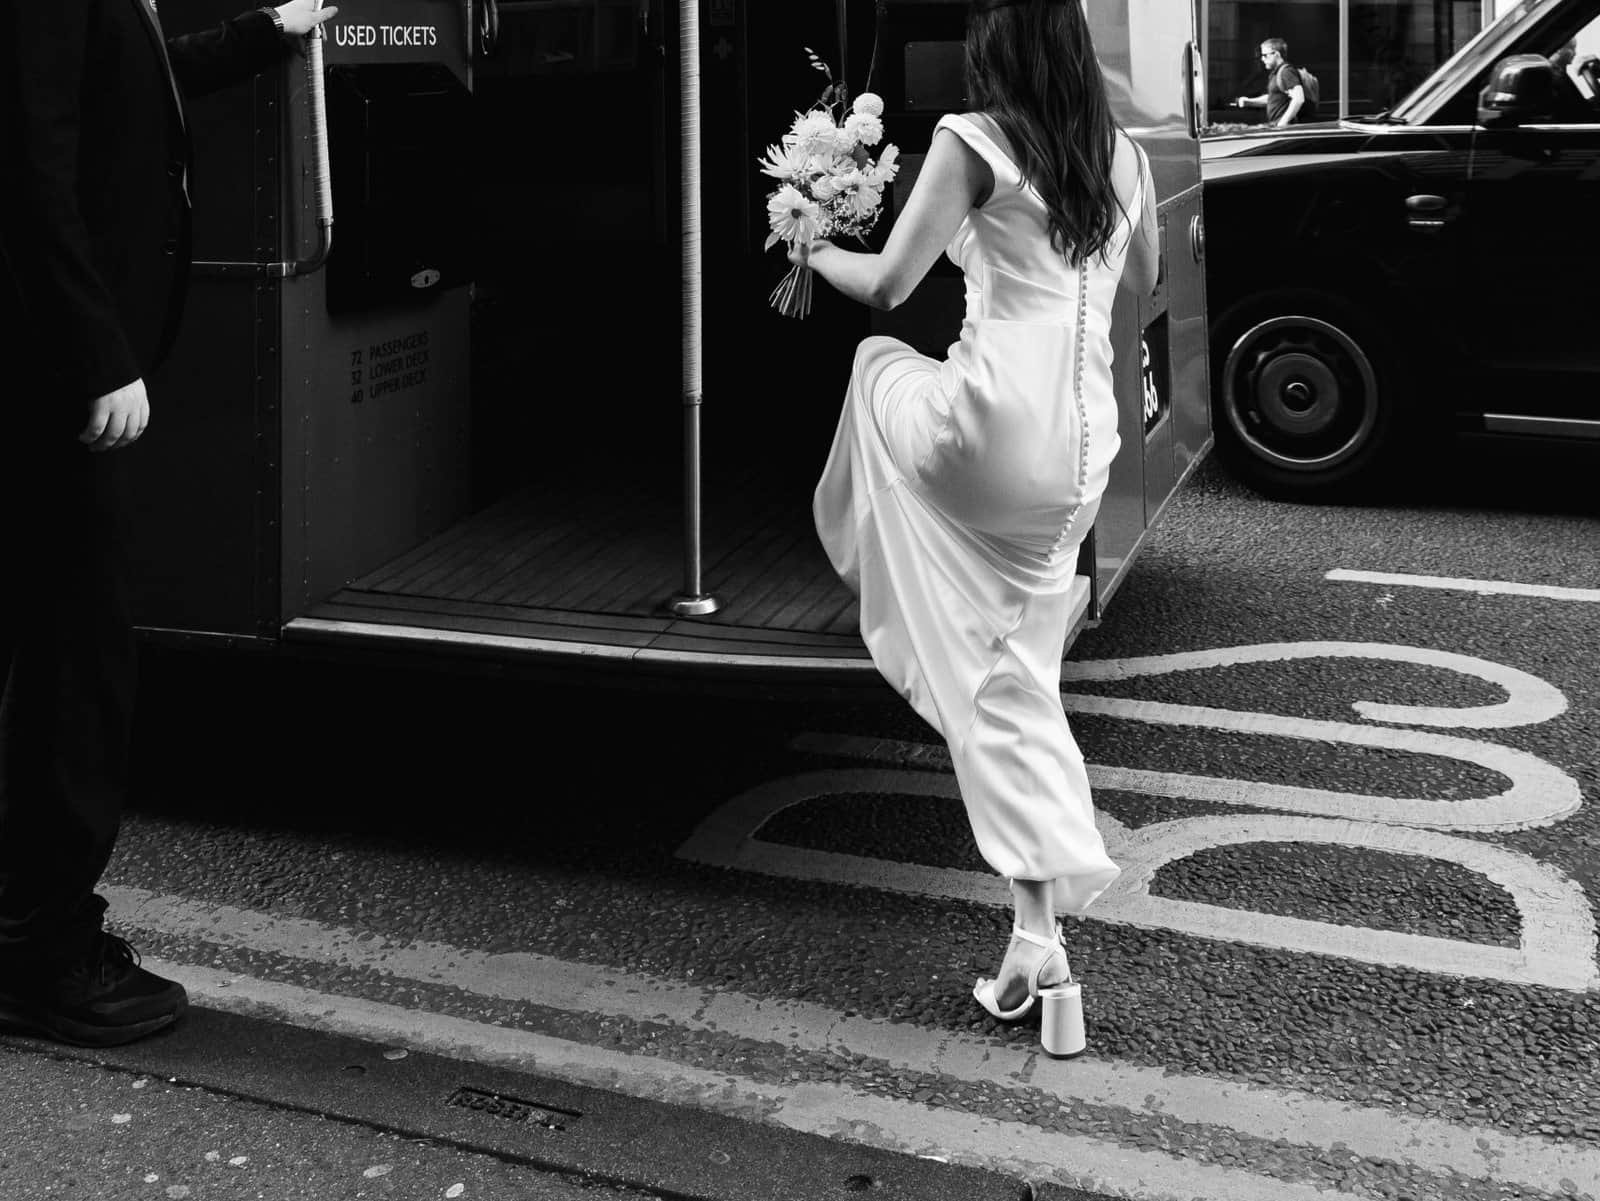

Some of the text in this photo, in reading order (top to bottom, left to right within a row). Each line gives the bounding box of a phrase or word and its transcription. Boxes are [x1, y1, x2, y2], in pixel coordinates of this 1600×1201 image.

[335, 24, 437, 47] USED TICKETS
[351, 331, 430, 368] 72 PASSENGERS
[351, 350, 430, 386] 32 LOWER DECK
[351, 365, 427, 404] 40 UPPER DECK
